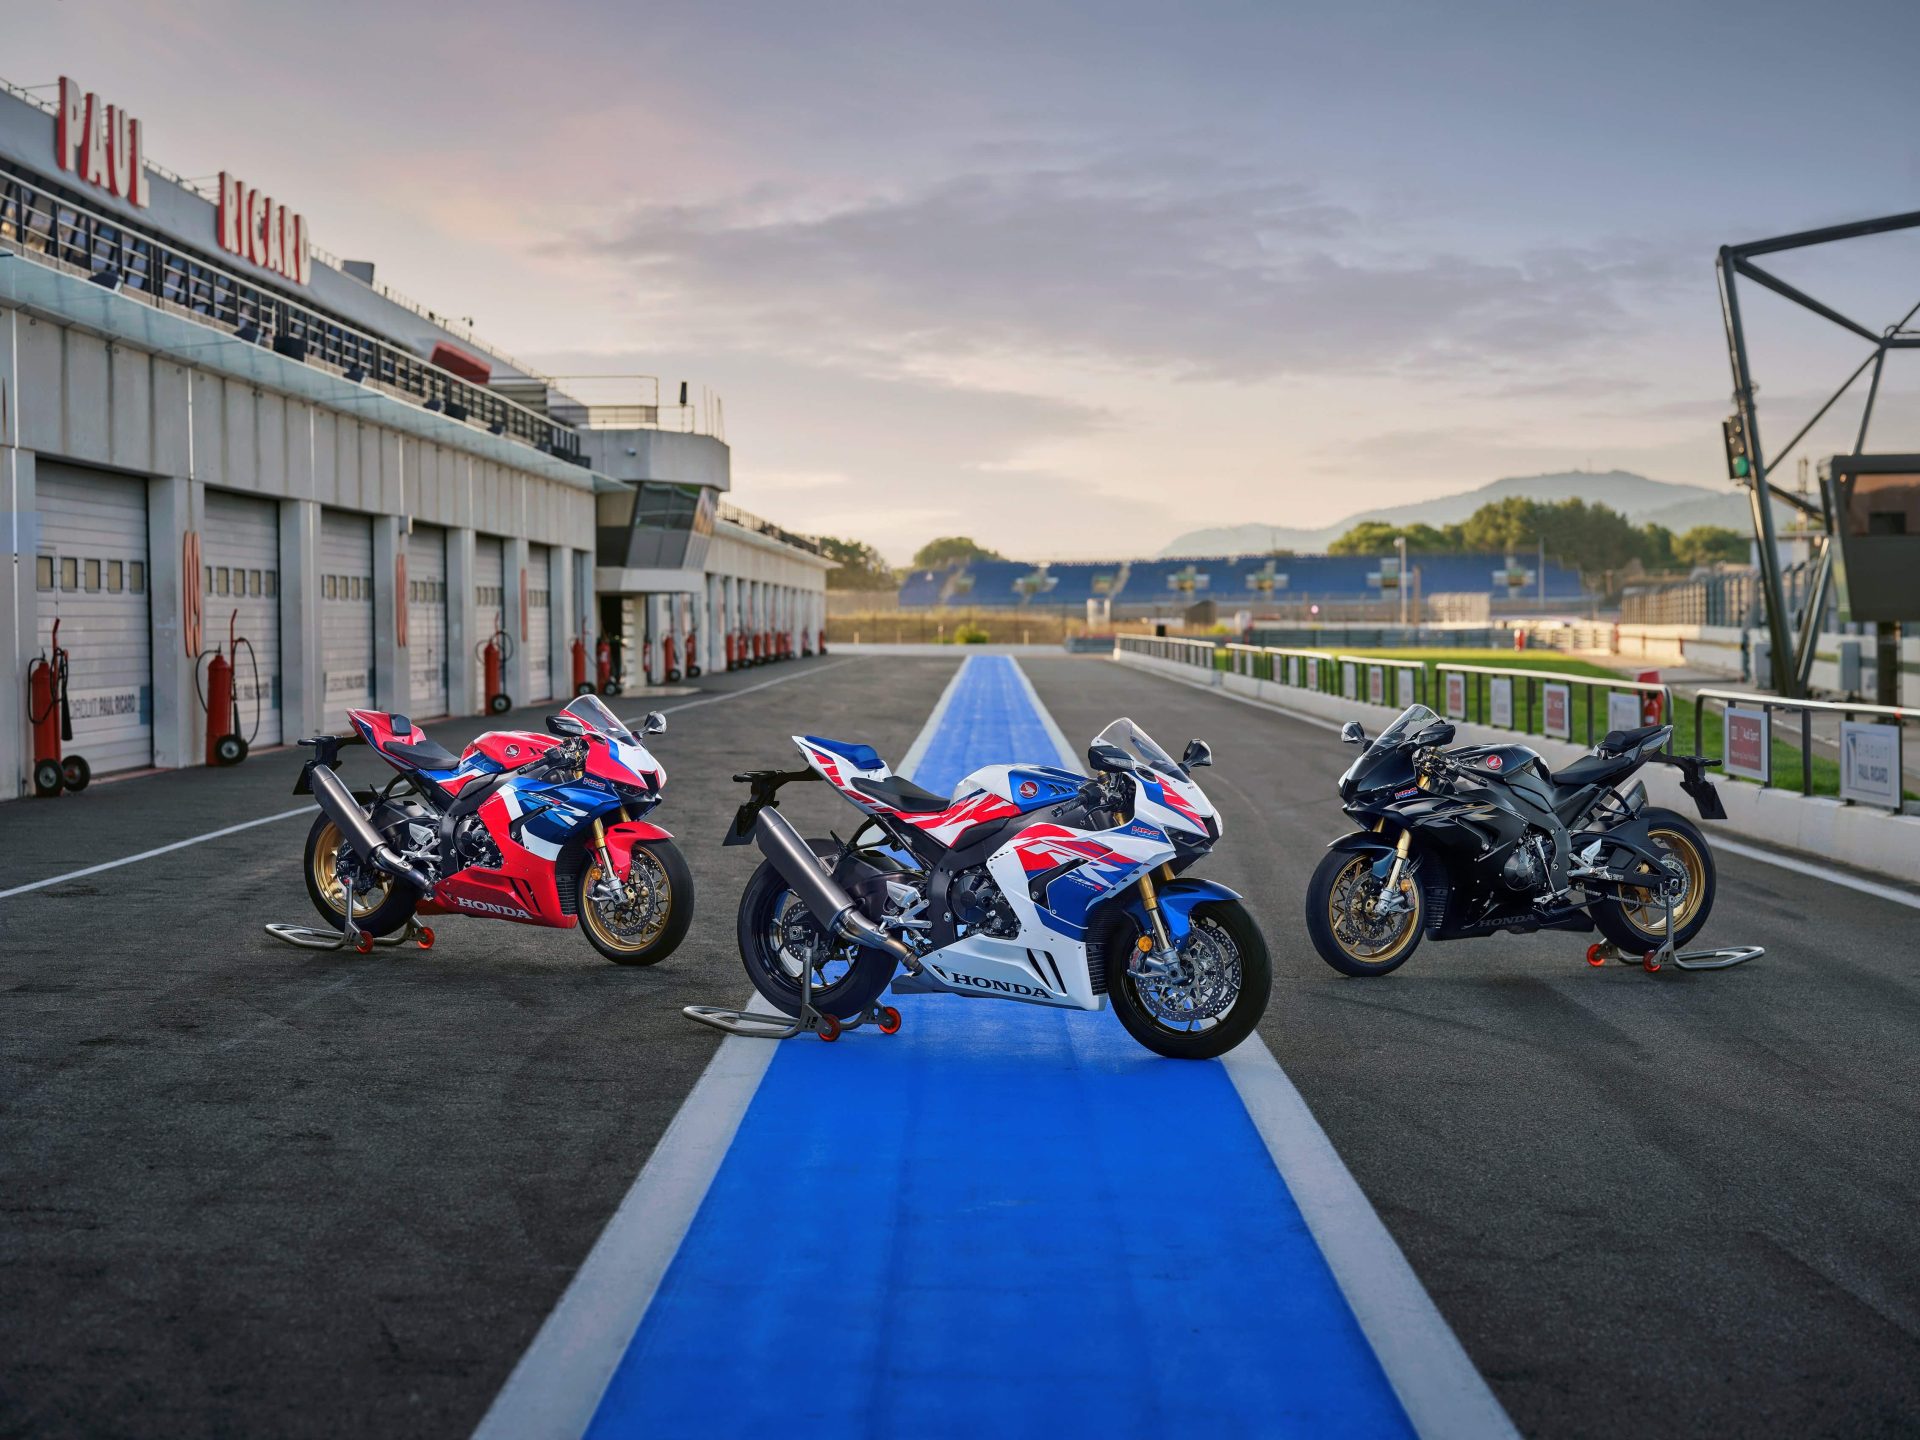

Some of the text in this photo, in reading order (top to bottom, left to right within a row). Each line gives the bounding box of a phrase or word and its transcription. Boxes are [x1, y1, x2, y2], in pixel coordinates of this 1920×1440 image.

[57, 75, 311, 286] PAUL RICARD
[99, 695, 114, 716] PAUL
[115, 693, 136, 714] RICARD
[1131, 825, 1160, 840] HRC
[456, 896, 533, 920] HONDA
[1478, 913, 1535, 928] HONDA
[951, 971, 1054, 1000] HONDA
